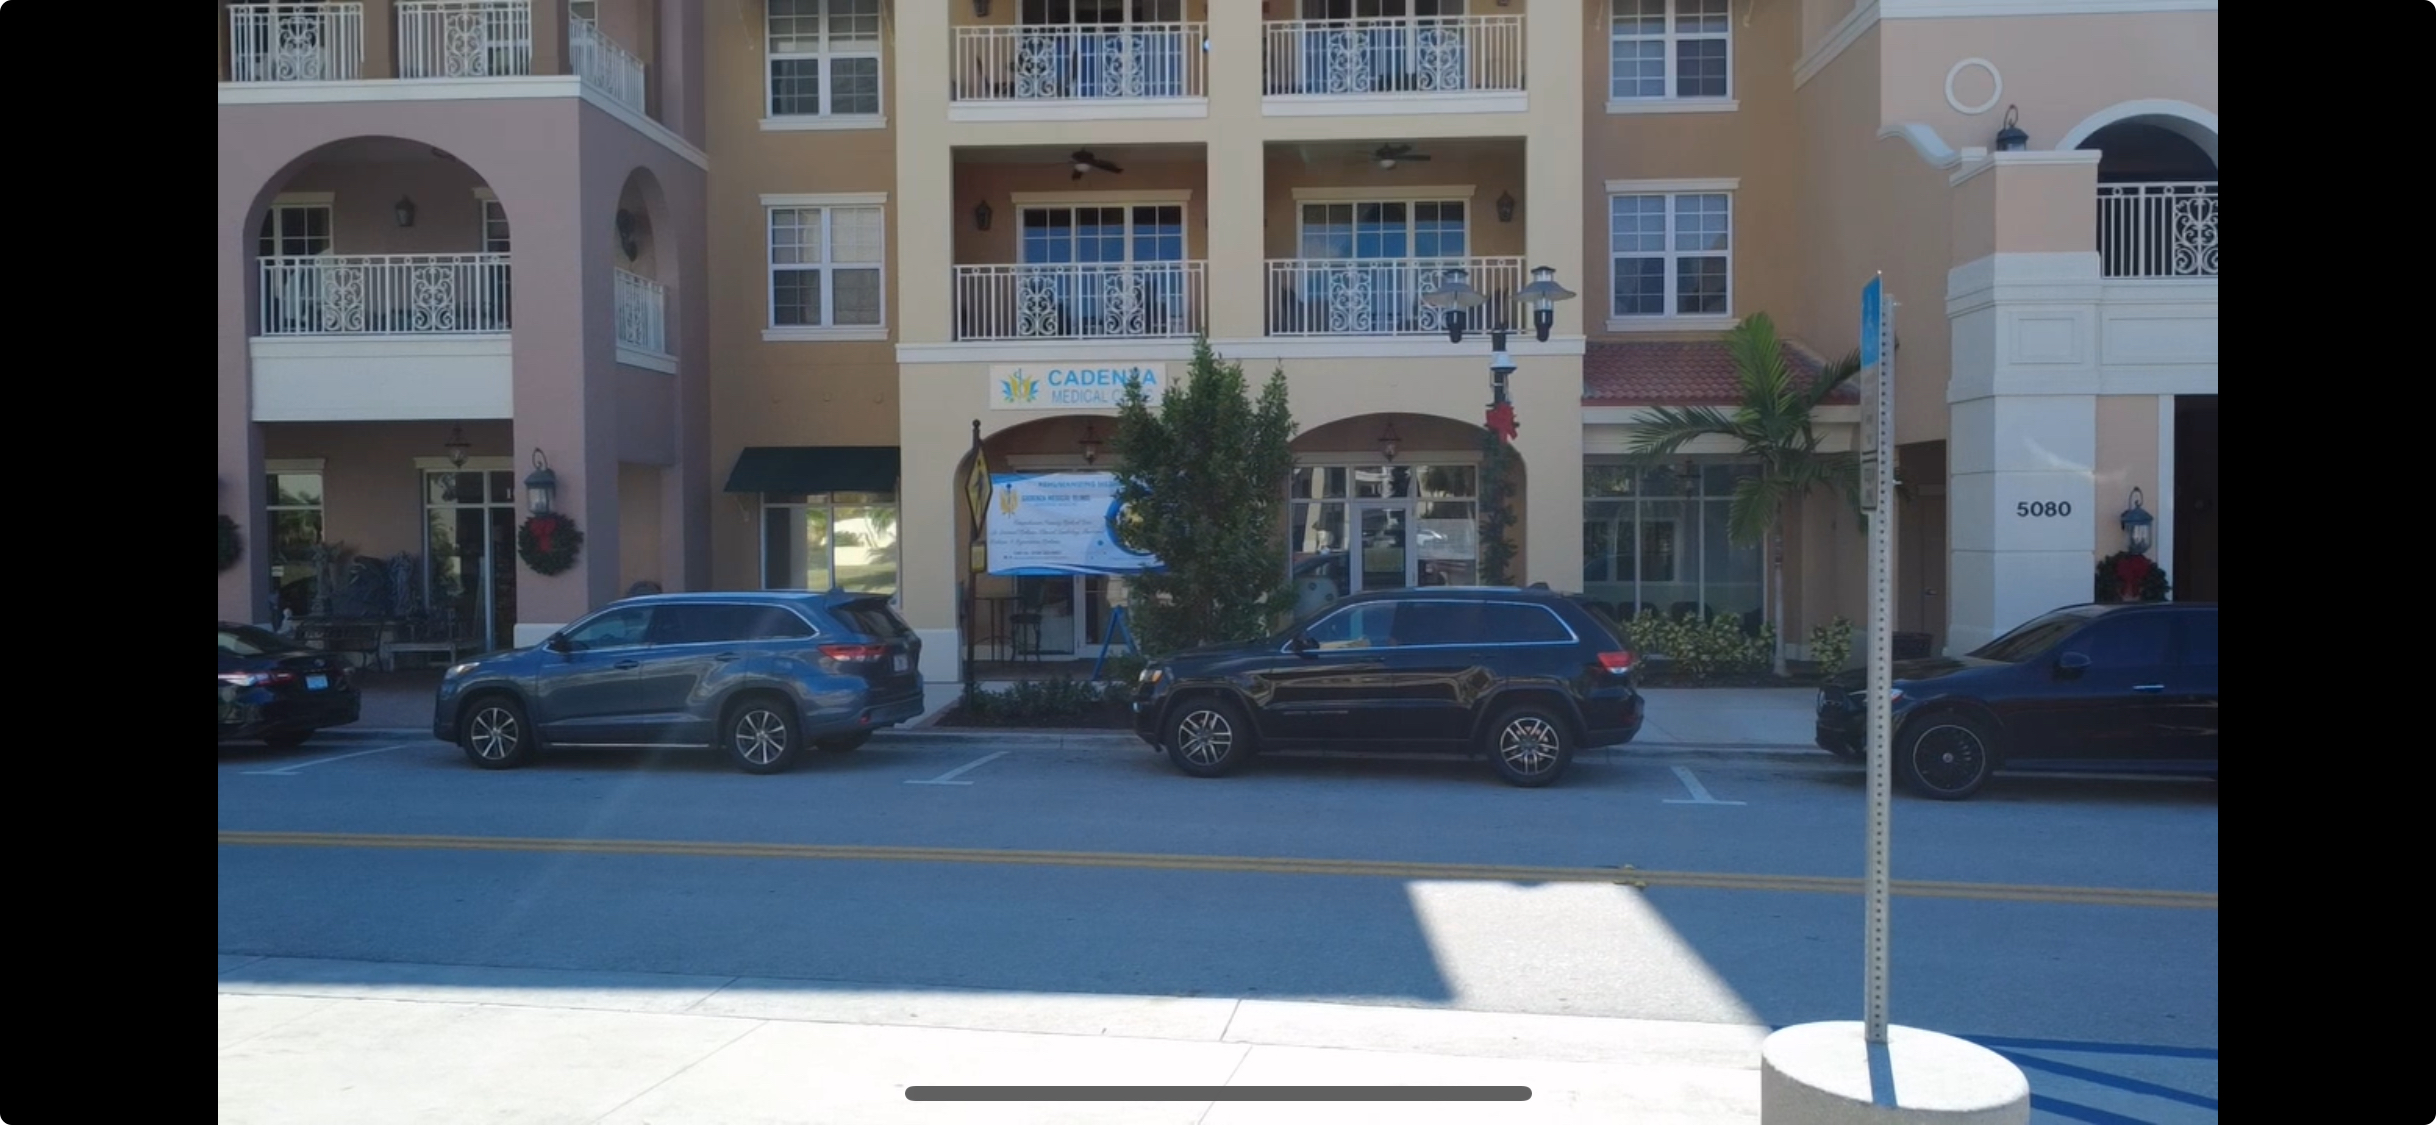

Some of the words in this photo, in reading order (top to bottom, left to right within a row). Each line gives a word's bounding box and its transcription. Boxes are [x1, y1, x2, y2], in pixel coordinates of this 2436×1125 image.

[1048, 369, 1157, 386] CADENA
[1051, 388, 1108, 404] MEDICAL
[2016, 501, 2072, 517] 5080
